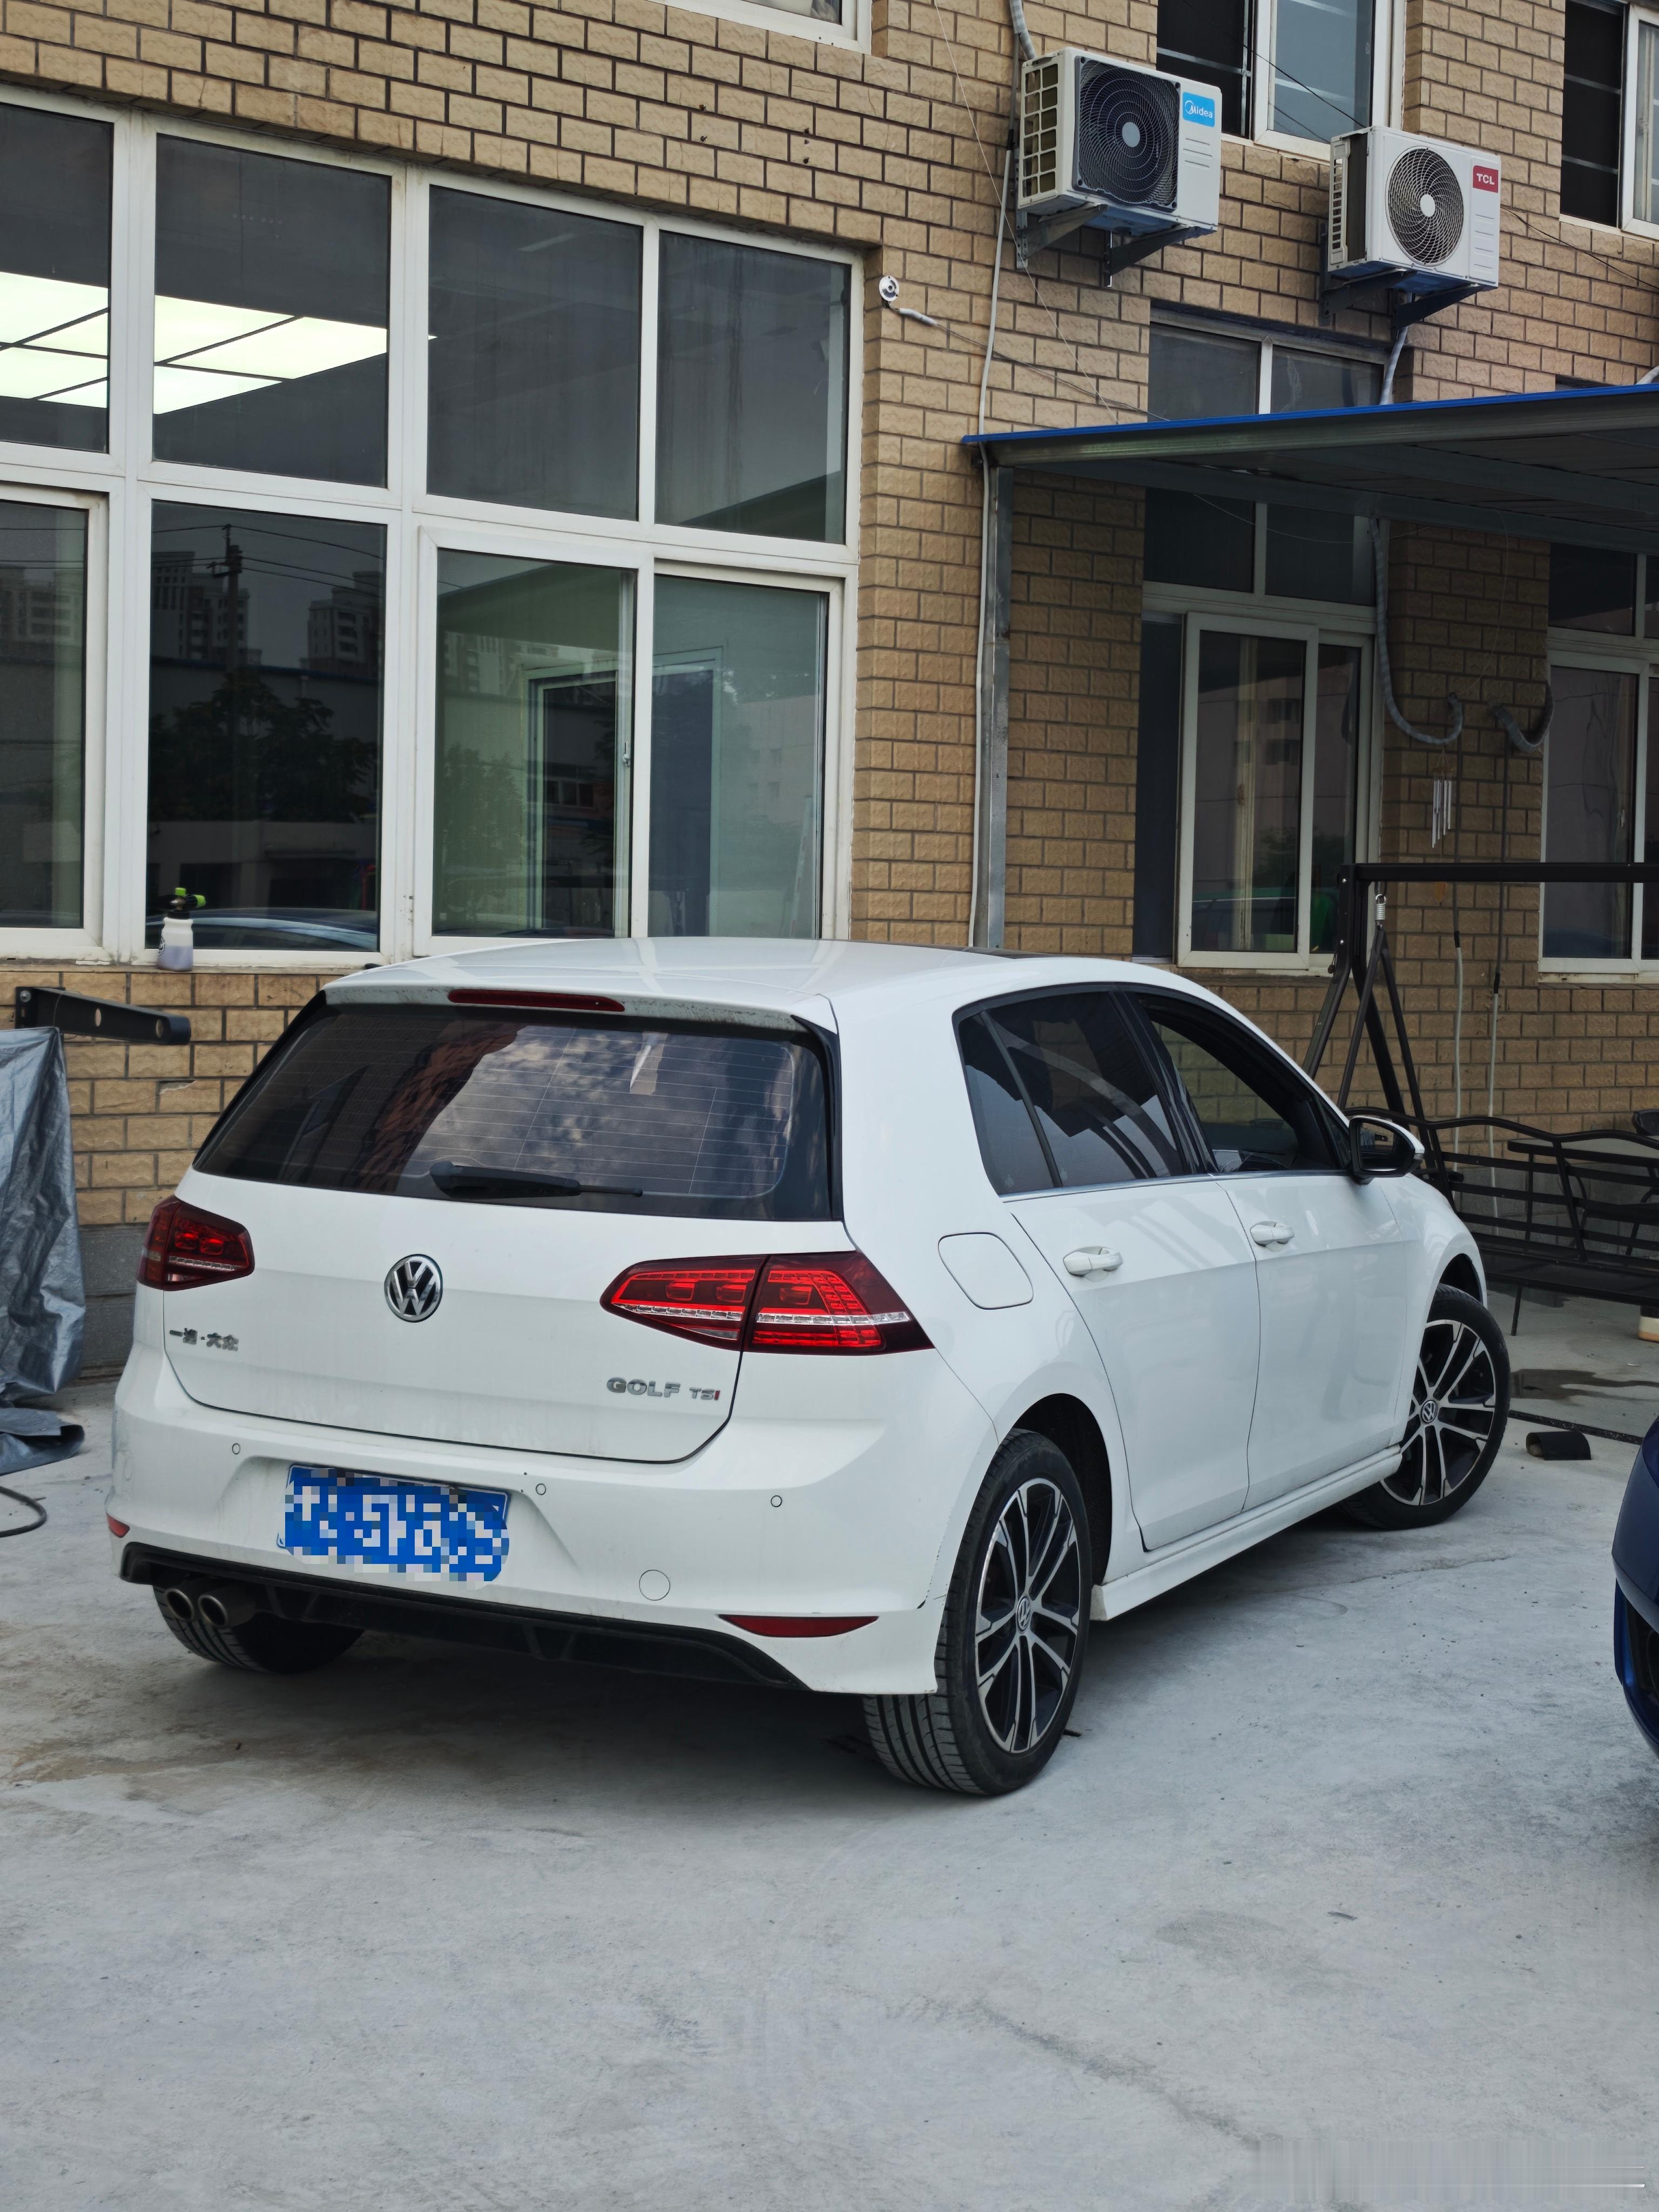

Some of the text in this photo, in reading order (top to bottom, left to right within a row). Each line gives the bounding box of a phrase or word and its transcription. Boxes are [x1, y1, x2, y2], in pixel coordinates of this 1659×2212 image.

[1185, 100, 1213, 118] Midea
[1476, 173, 1495, 185] TCL
[606, 1377, 721, 1401] GOLF TSI
